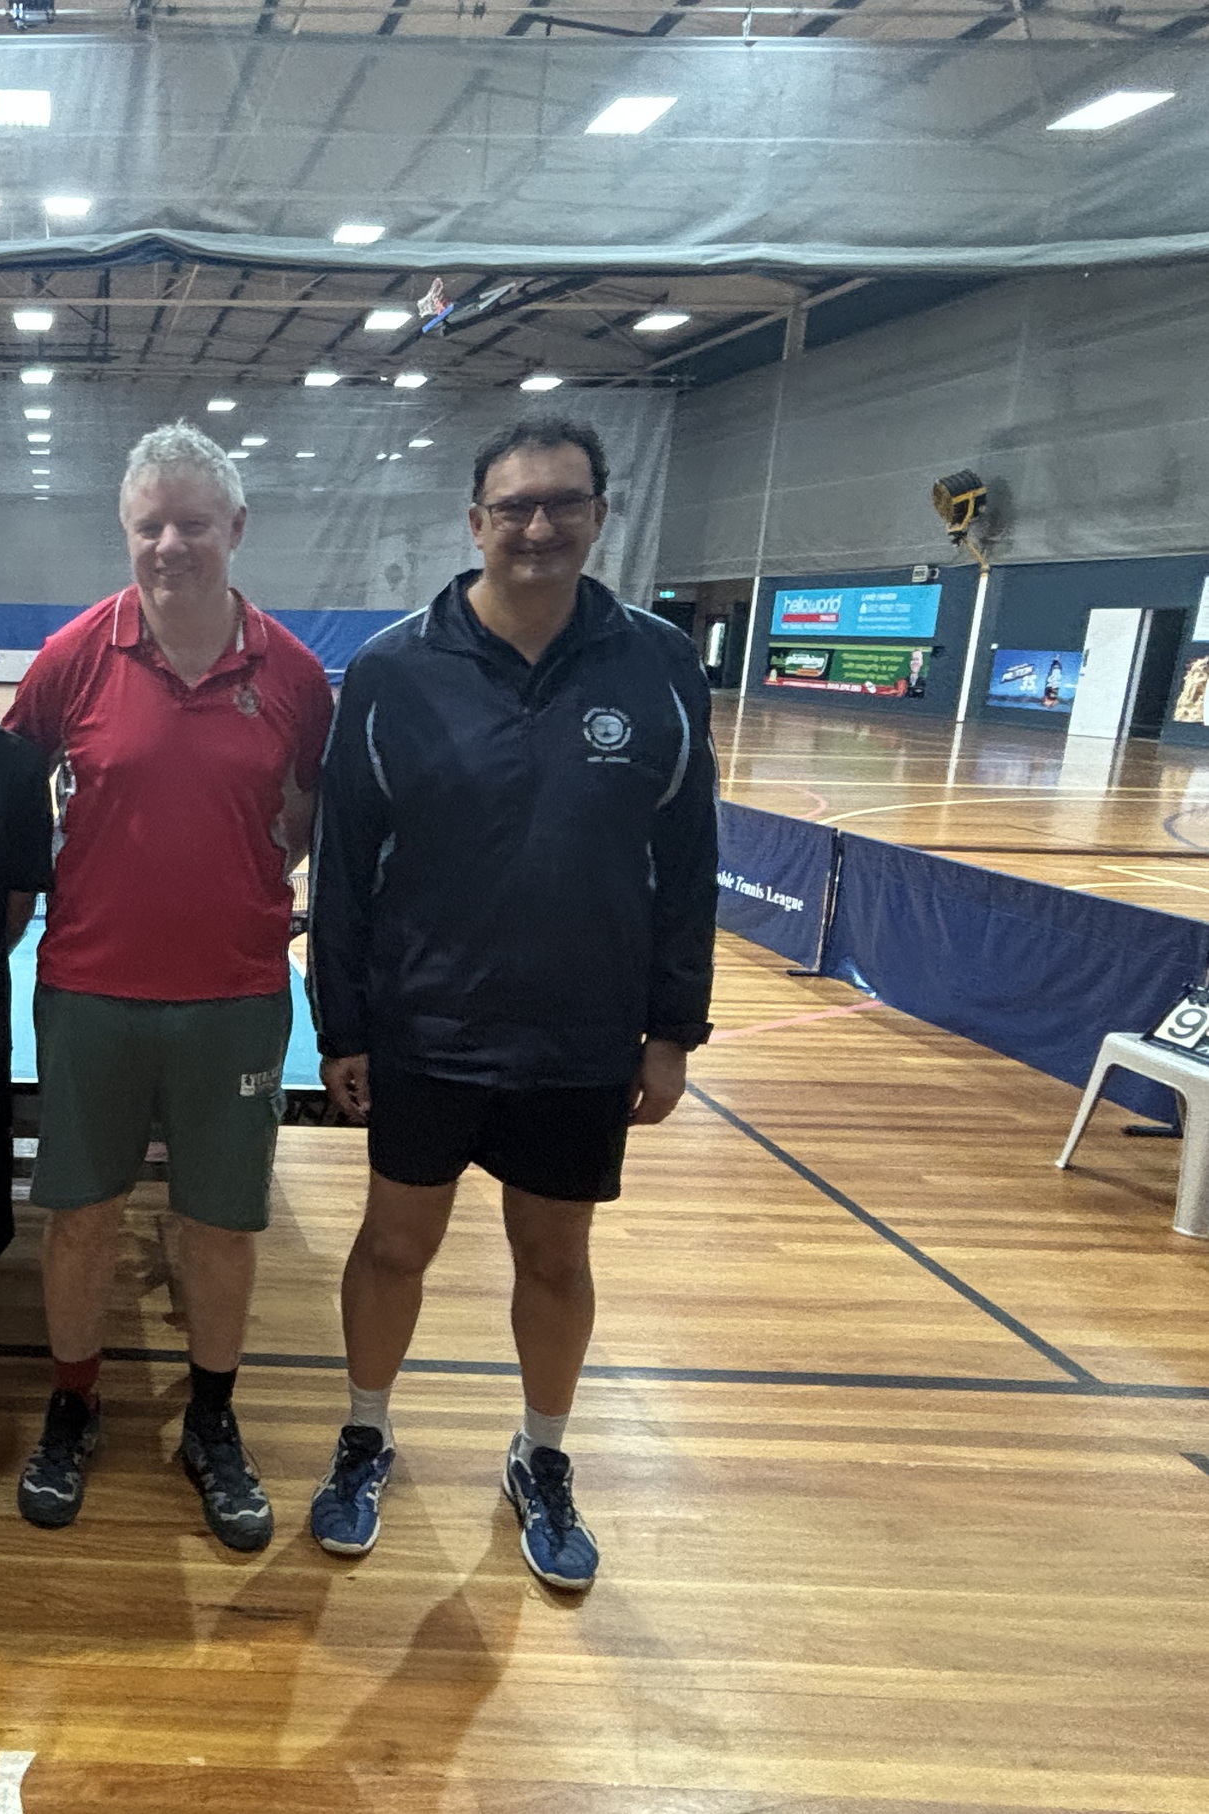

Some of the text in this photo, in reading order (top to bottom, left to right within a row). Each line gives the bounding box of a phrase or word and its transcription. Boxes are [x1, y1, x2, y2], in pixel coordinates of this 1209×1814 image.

[716, 870, 804, 912] able Tennis League
[1168, 1008, 1208, 1039] 9
